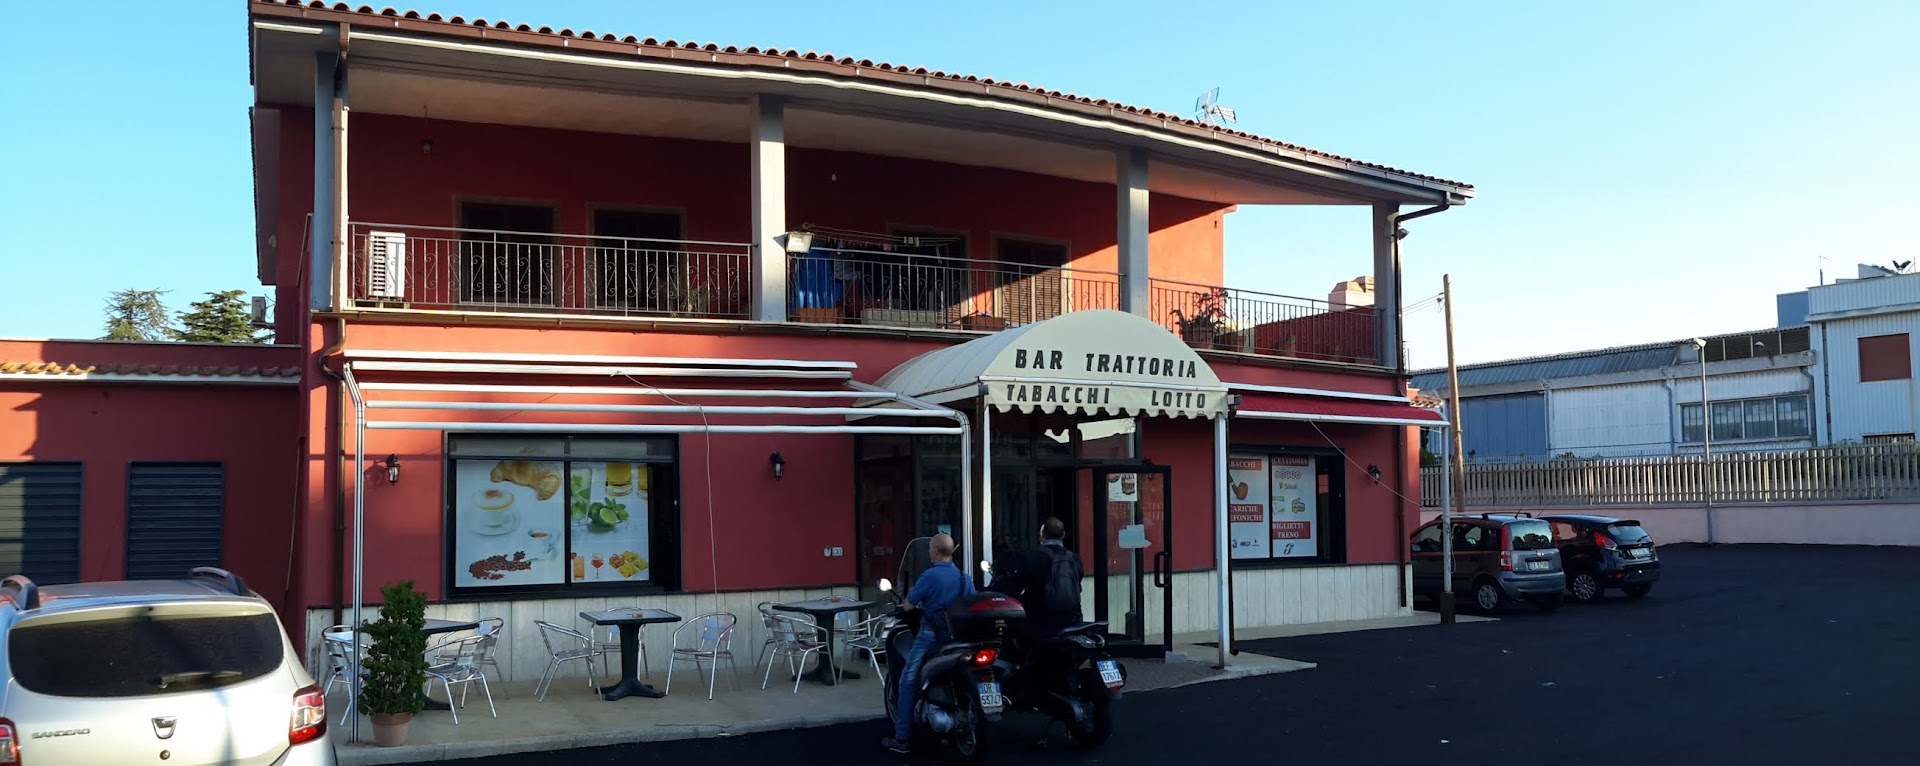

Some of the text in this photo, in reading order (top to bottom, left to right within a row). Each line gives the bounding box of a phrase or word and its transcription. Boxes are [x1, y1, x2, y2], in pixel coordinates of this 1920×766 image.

[1015, 348, 1196, 378] BAR TRATTORIA
[1006, 384, 1206, 409] TABACCHI LOTTO
[31, 728, 91, 739] SANDERO
